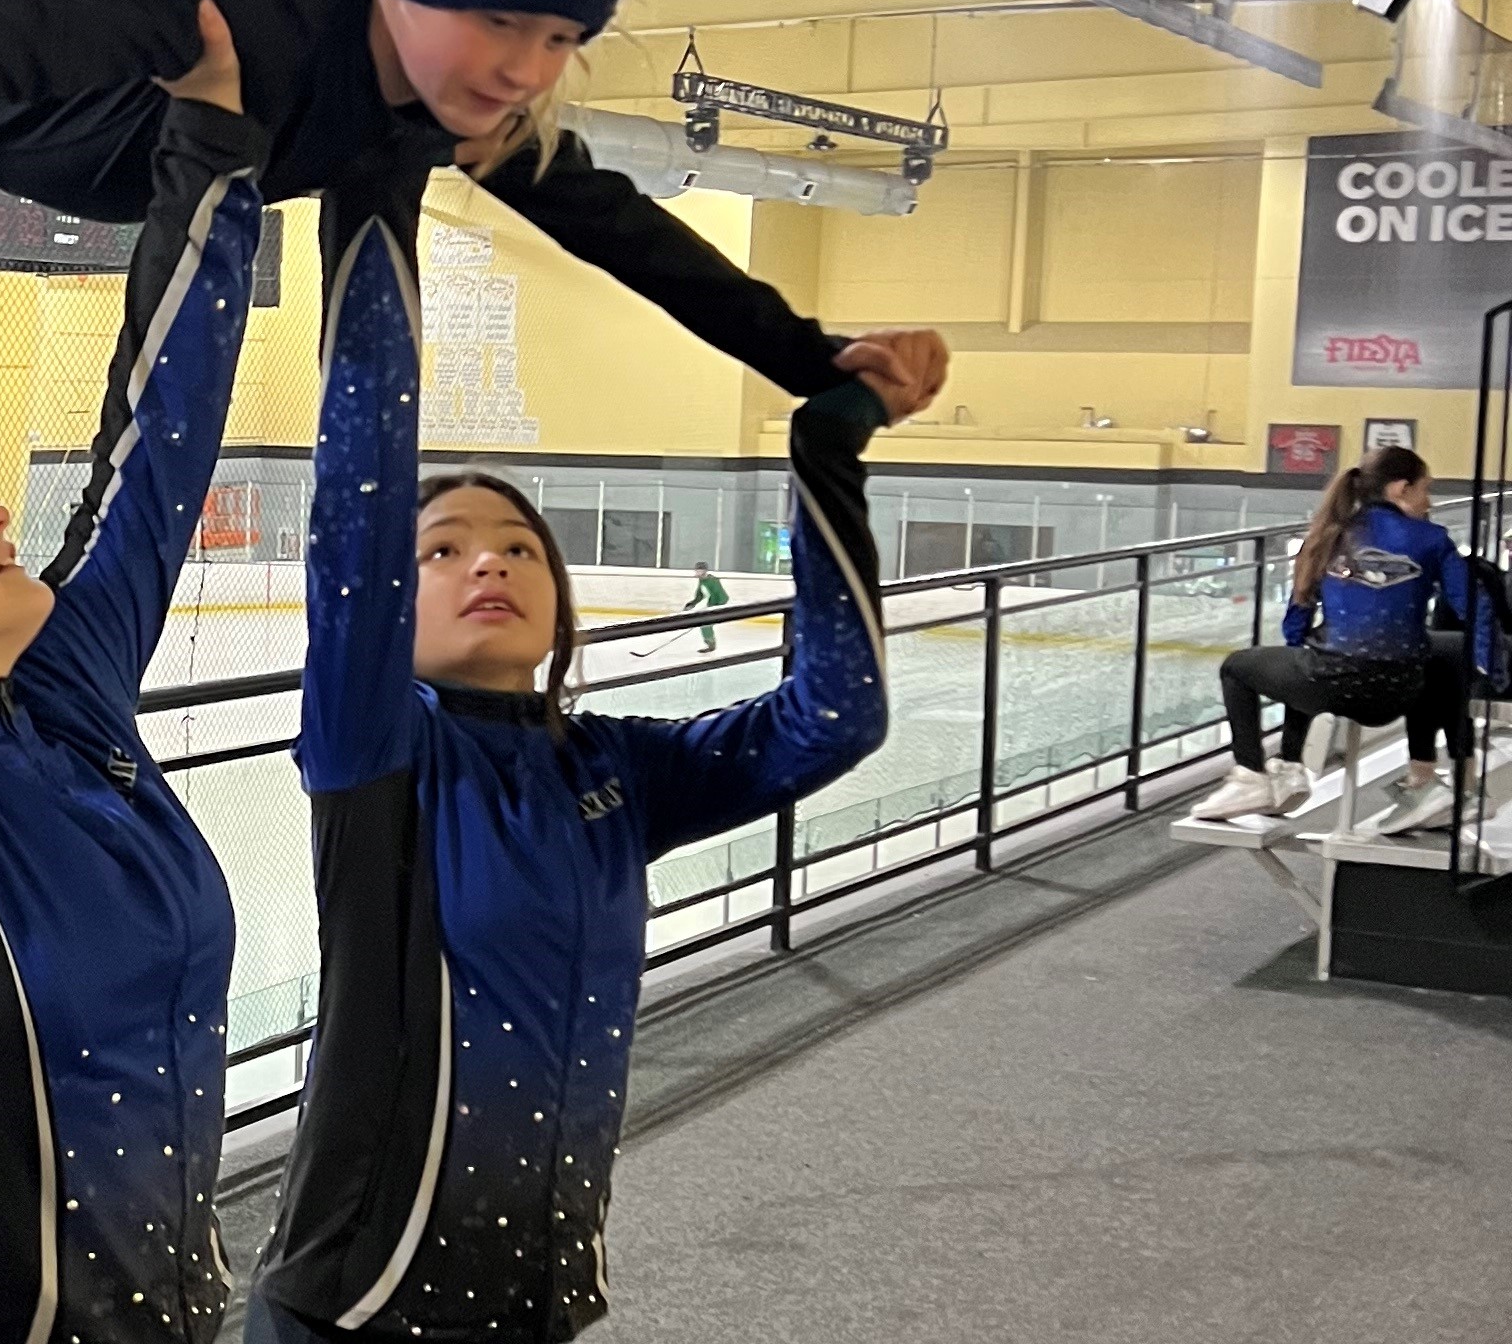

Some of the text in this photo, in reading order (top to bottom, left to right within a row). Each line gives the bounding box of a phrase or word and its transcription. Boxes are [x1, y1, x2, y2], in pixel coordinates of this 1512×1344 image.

[1337, 160, 1512, 200] COOLE
[1336, 204, 1512, 243] ON ICE
[1324, 334, 1422, 373] FIESTA
